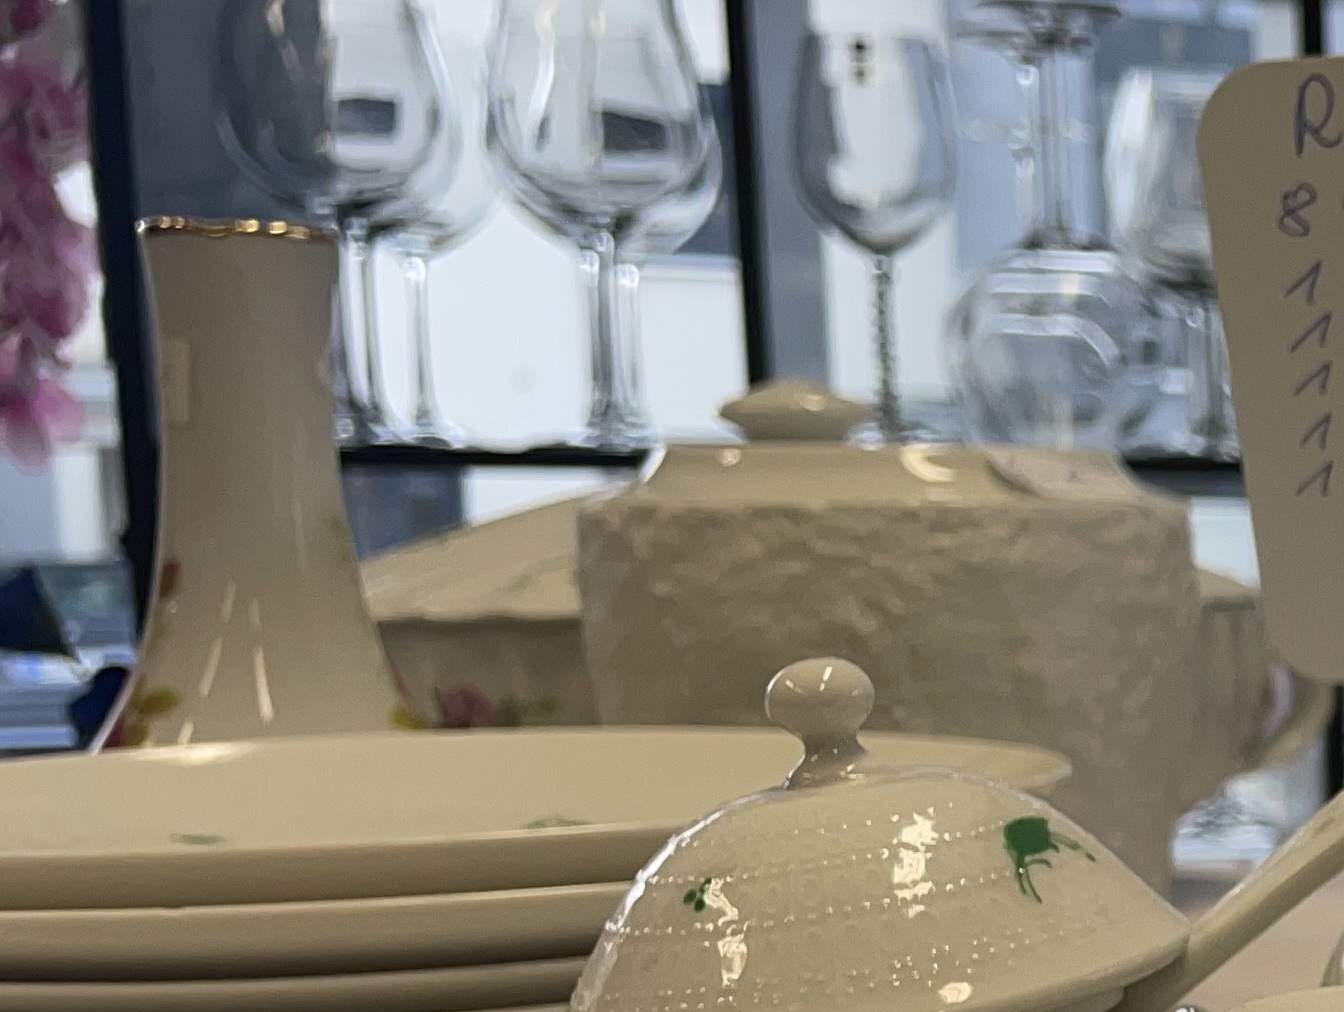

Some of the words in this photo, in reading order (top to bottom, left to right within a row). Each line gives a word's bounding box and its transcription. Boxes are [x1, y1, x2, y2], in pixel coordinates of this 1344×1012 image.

[1278, 182, 1318, 238] 8
[1284, 260, 1322, 305] 1
[1290, 311, 1332, 353] 1
[1294, 360, 1333, 397] 1
[1300, 411, 1333, 450] 1
[1296, 460, 1333, 497] 1
